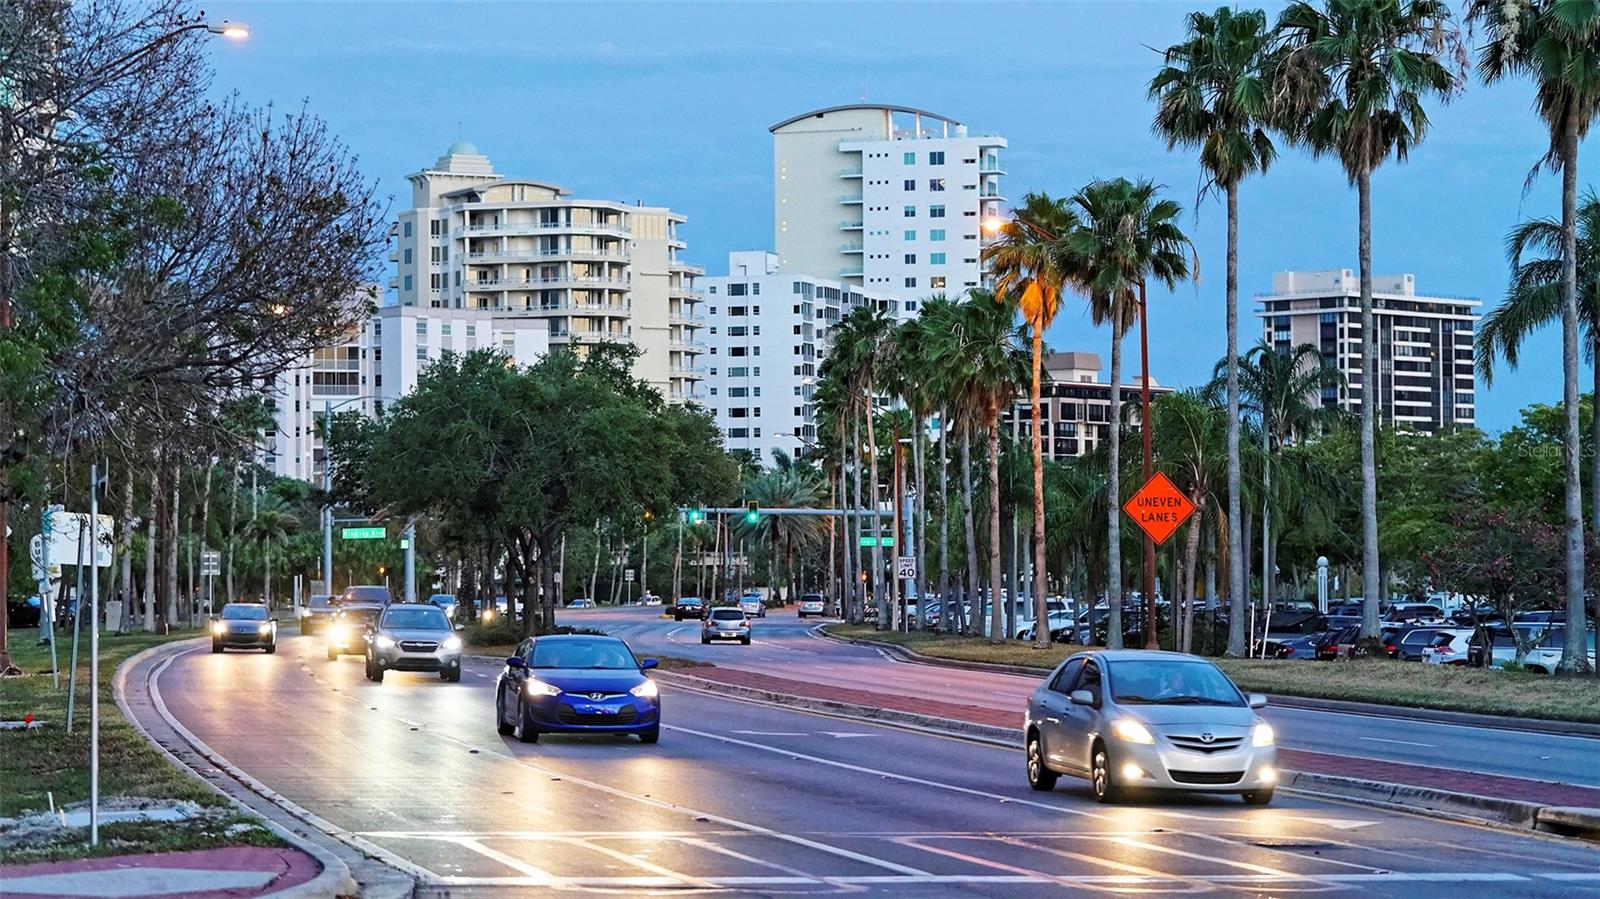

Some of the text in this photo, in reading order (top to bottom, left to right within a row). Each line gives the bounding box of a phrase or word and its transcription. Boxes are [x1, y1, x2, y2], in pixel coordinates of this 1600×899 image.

[1137, 497, 1181, 507] UNEVEN
[1142, 513, 1178, 522] LANES
[899, 569, 915, 577] 40
